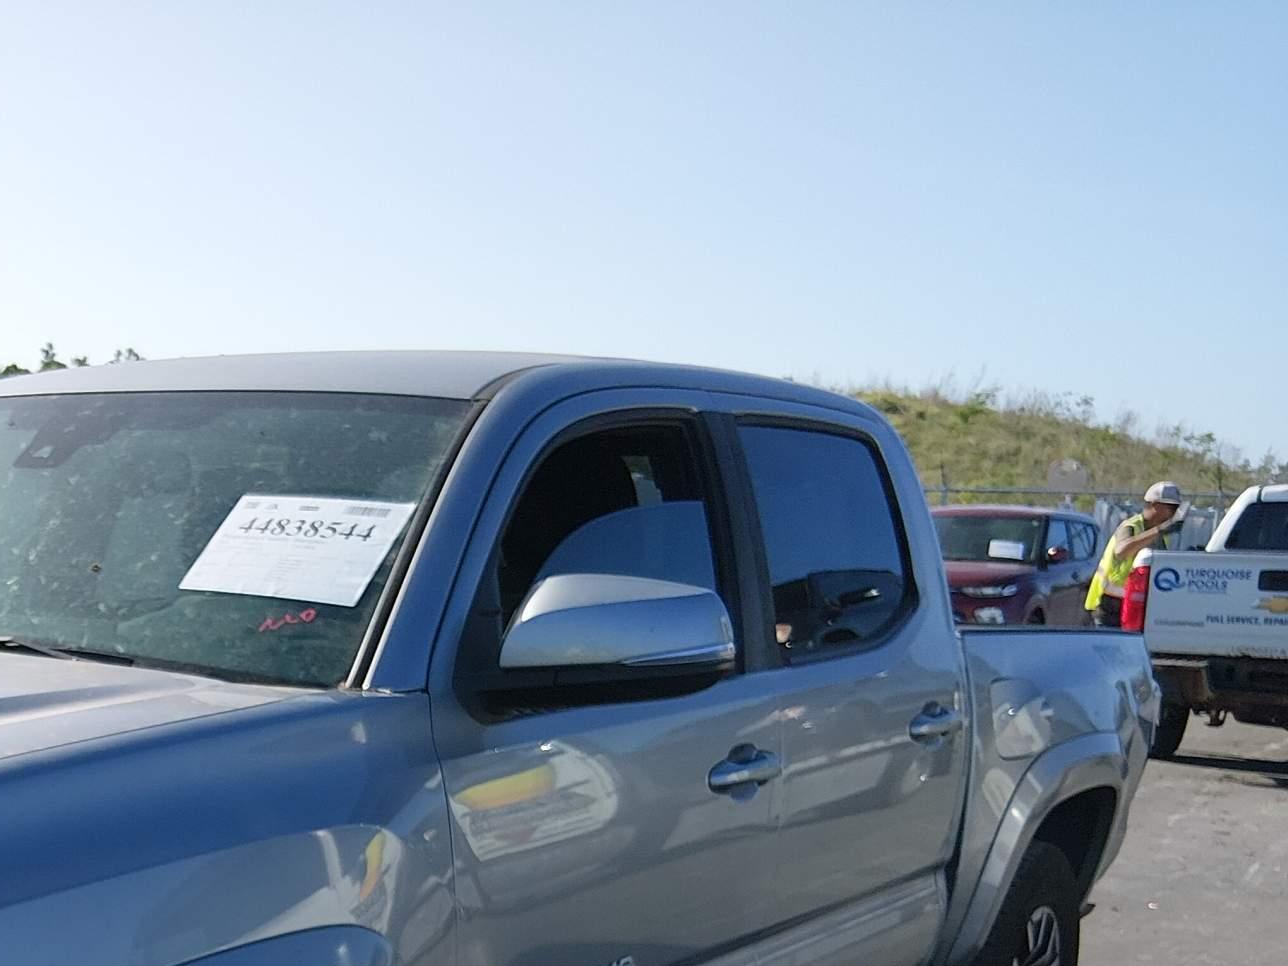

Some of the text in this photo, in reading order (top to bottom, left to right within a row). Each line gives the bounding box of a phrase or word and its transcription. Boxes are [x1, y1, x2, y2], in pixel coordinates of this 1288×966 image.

[239, 517, 377, 542] 44838544
[1186, 568, 1252, 581] TURQUOISE
[1187, 579, 1228, 590] POOLS
